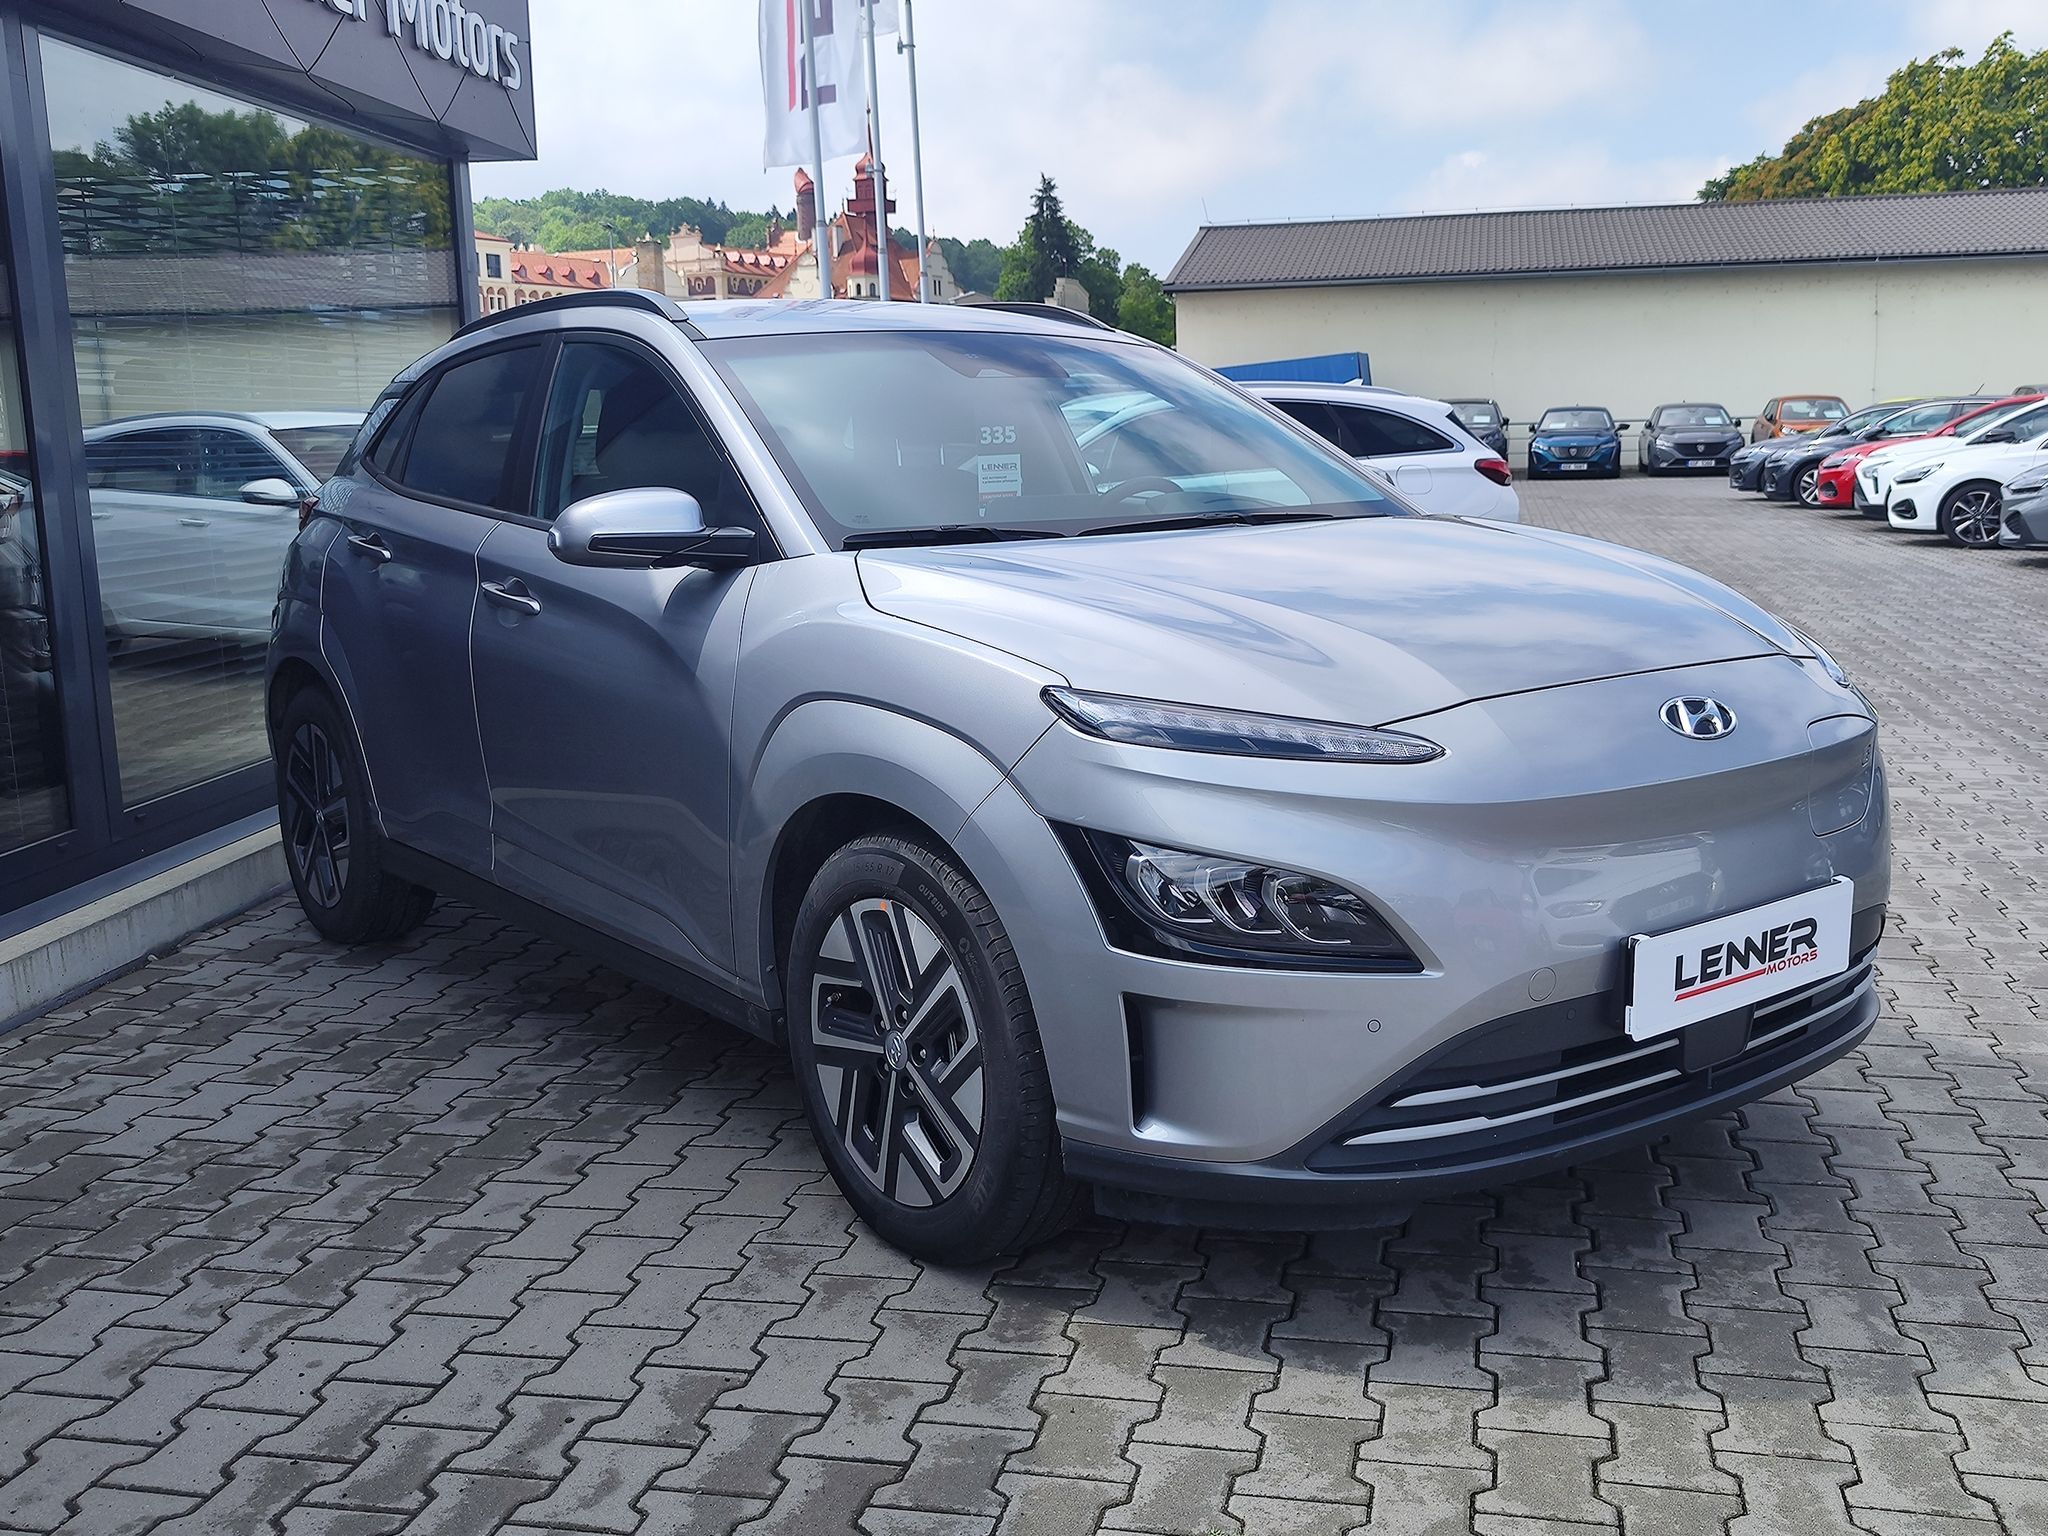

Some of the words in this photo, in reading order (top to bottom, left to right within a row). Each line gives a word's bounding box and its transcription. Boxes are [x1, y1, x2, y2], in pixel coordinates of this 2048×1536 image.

[980, 425, 1017, 444] 335
[918, 883, 949, 918] OUTSIDE
[1674, 917, 1818, 992] LENNER
[1766, 949, 1818, 976] MOTORS
